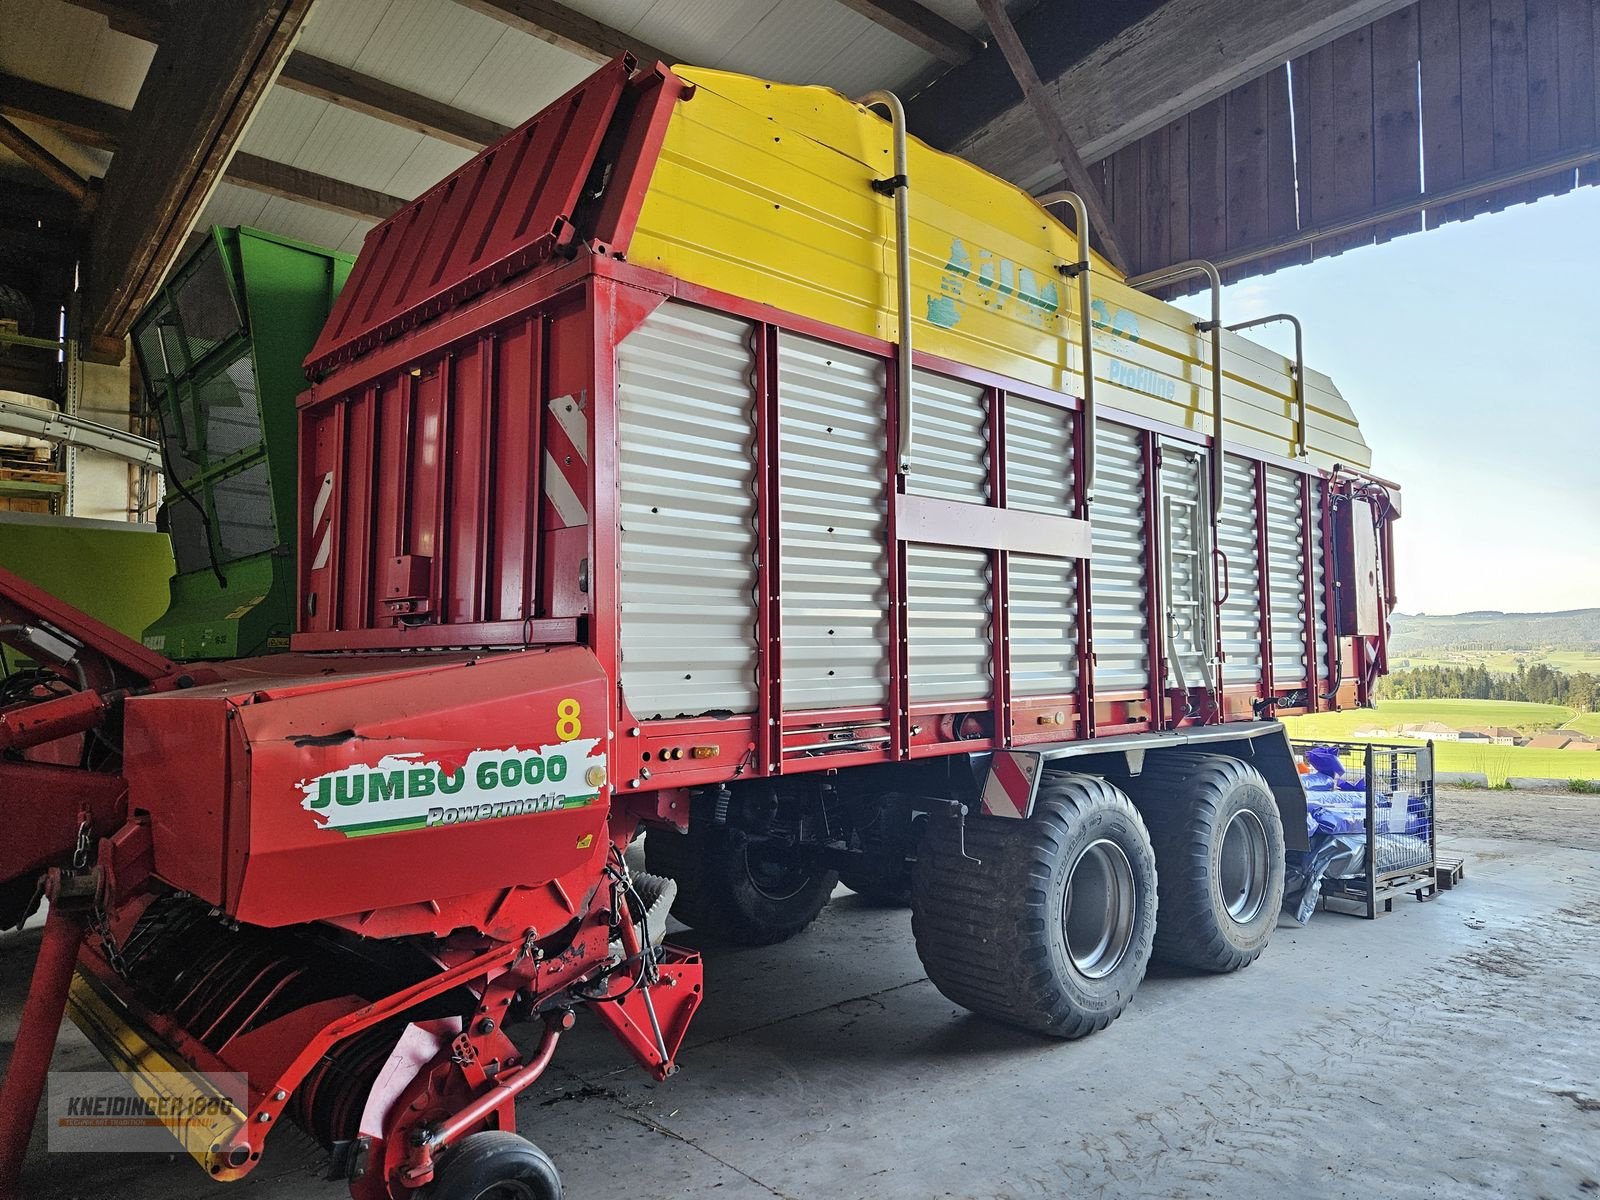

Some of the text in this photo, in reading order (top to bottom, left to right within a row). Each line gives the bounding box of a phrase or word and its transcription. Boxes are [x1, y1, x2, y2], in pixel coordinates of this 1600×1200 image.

[555, 698, 582, 742] 8
[310, 754, 568, 809] JUMBO 6000
[426, 792, 566, 827] Powermatic
